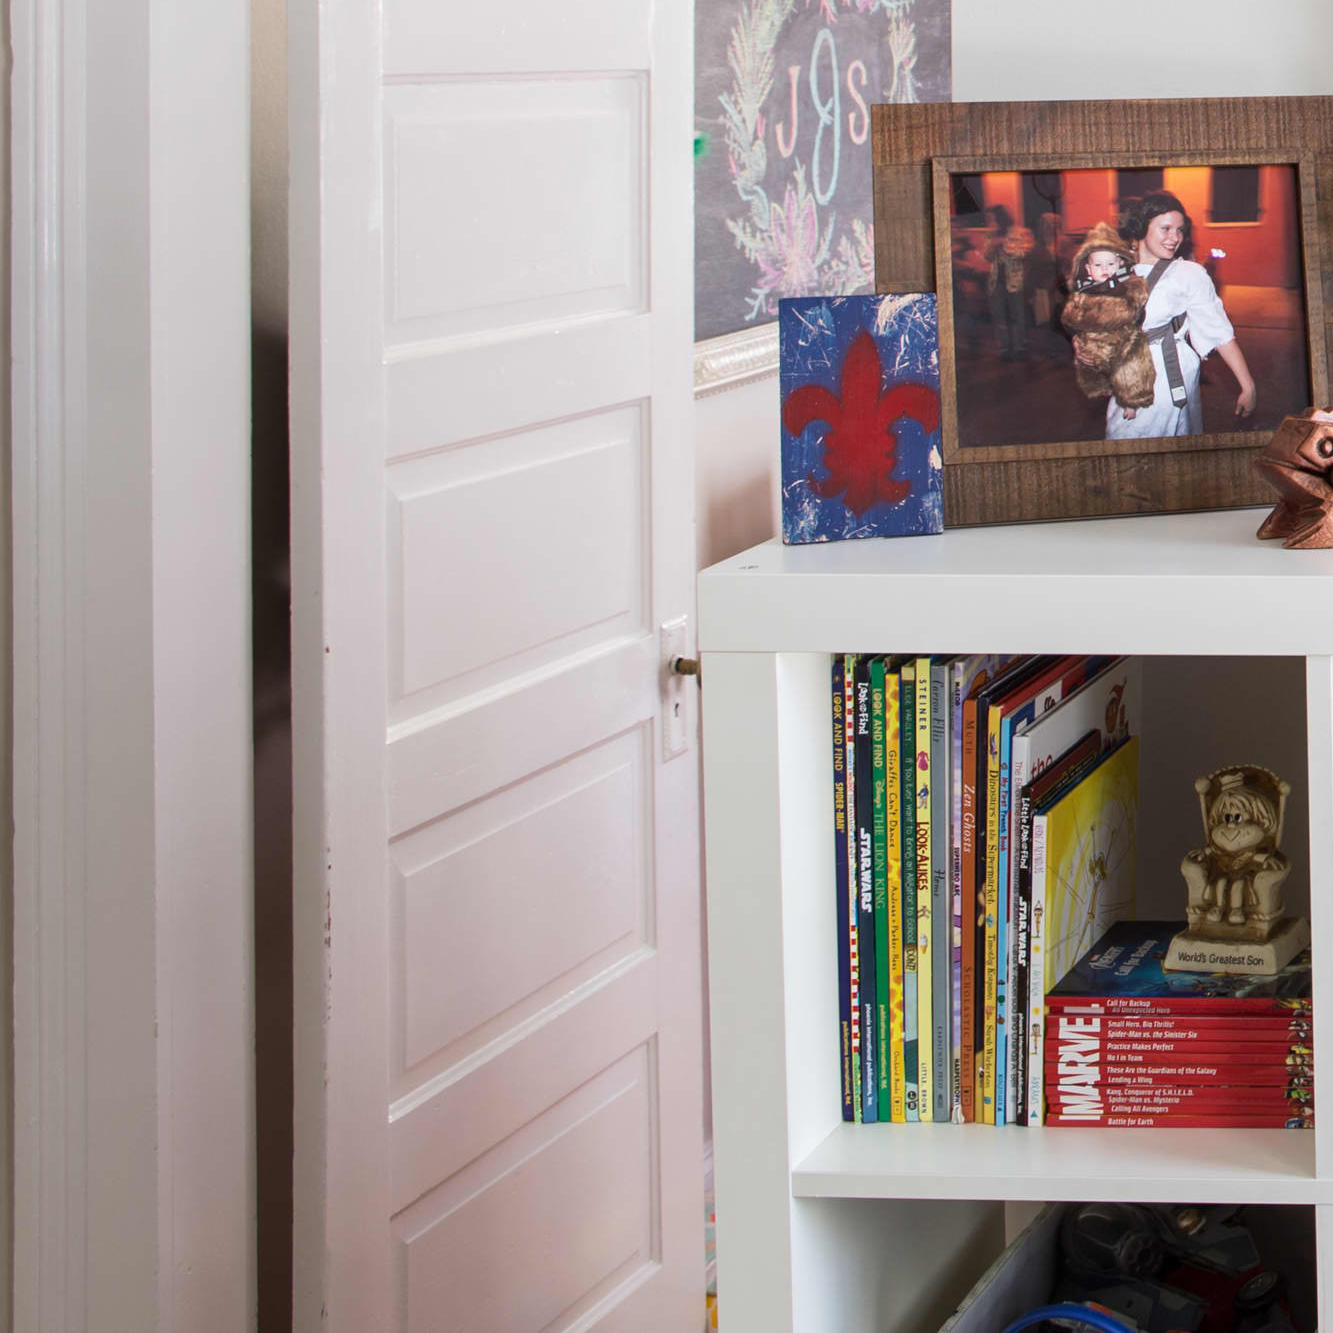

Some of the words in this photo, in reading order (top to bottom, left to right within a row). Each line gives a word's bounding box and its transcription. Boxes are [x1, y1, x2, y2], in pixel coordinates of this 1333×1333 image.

[833, 692, 842, 719] LOOK
[873, 688, 882, 715] LOOK
[834, 722, 843, 744] AND
[873, 719, 882, 741] AND
[966, 720, 975, 755] MUTH
[834, 747, 843, 771] FIND
[874, 745, 883, 768] FIND
[989, 769, 999, 817] Dinosaurs
[1000, 777, 1008, 788] My
[835, 782, 844, 831] SPIDER-MAN
[889, 793, 897, 815] Can't
[964, 784, 975, 807] Zen
[875, 813, 884, 834] THE
[889, 820, 897, 848] Dance
[906, 826, 913, 835] to
[963, 813, 975, 853] Ghosts
[989, 819, 997, 827] in
[989, 830, 997, 841] the
[1000, 836, 1008, 851] Book
[875, 843, 885, 871] LION
[906, 861, 912, 870] an
[917, 821, 929, 890] LOOK-ALIKES
[987, 845, 997, 904] Supermarket
[875, 878, 885, 909] KING
[1178, 952, 1206, 963] World's
[1210, 953, 1245, 965] Greatest
[1247, 955, 1264, 966] Son
